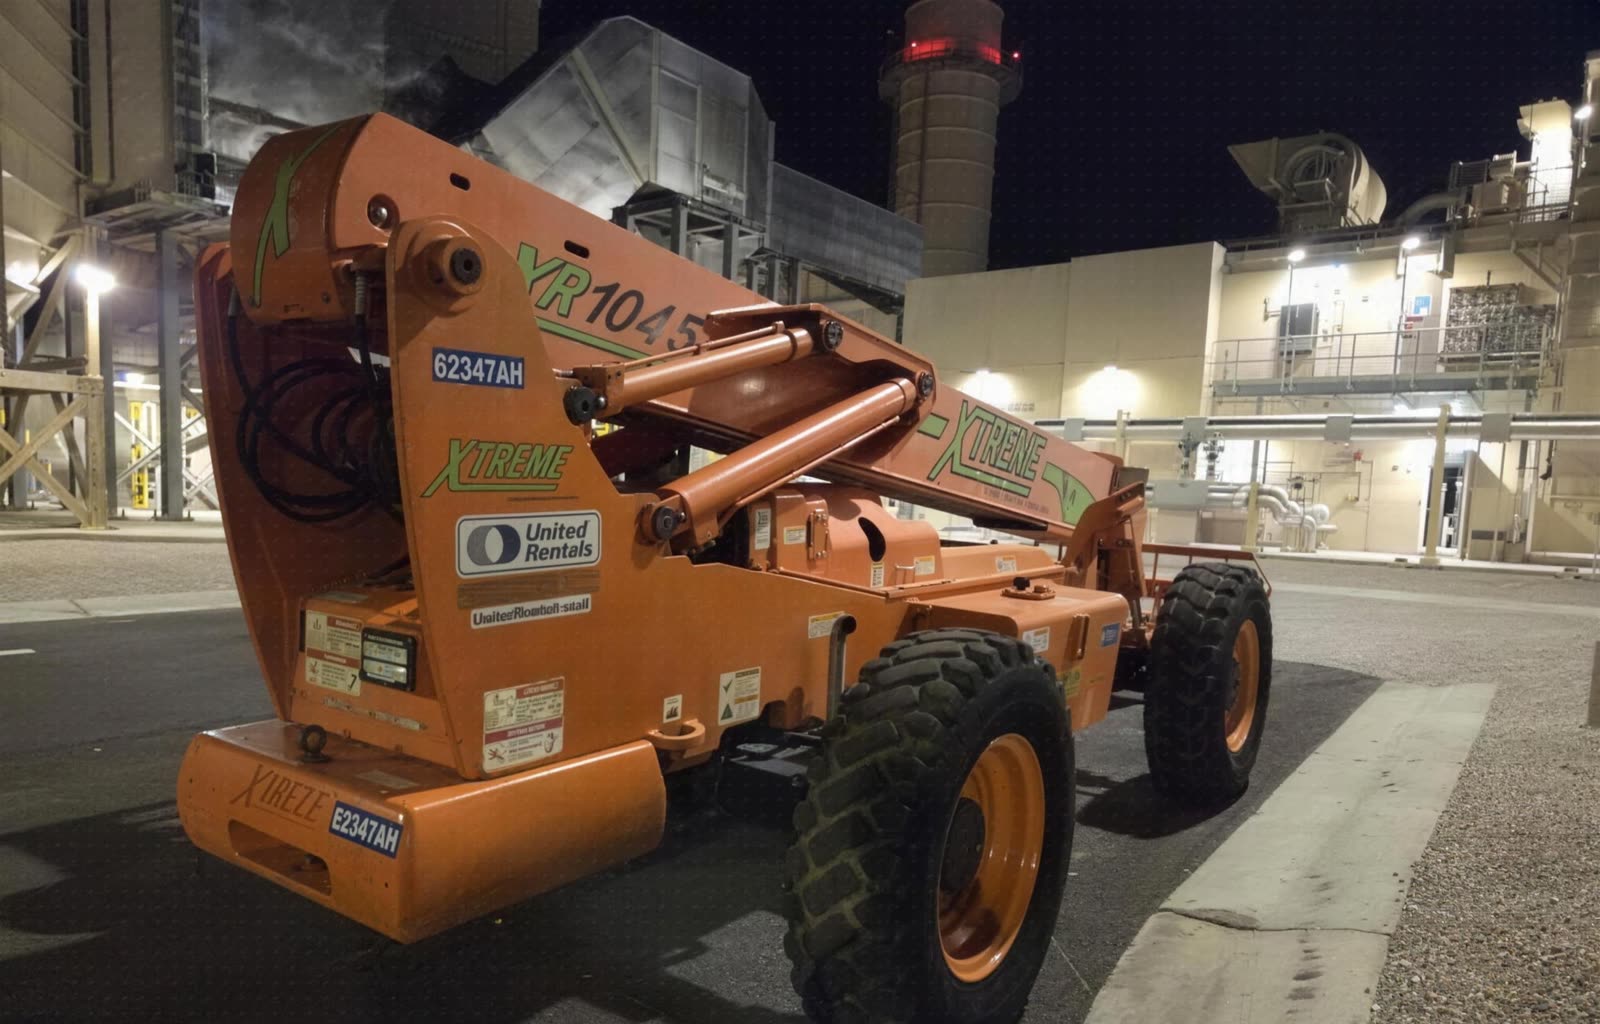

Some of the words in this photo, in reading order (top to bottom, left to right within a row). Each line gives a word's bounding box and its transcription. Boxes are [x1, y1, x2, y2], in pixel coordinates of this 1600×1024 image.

[433, 353, 523, 386] 62347AH
[420, 438, 575, 498] XTREME
[526, 520, 590, 541] United
[524, 540, 593, 563] Rentals
[331, 806, 400, 854] E2347AH
